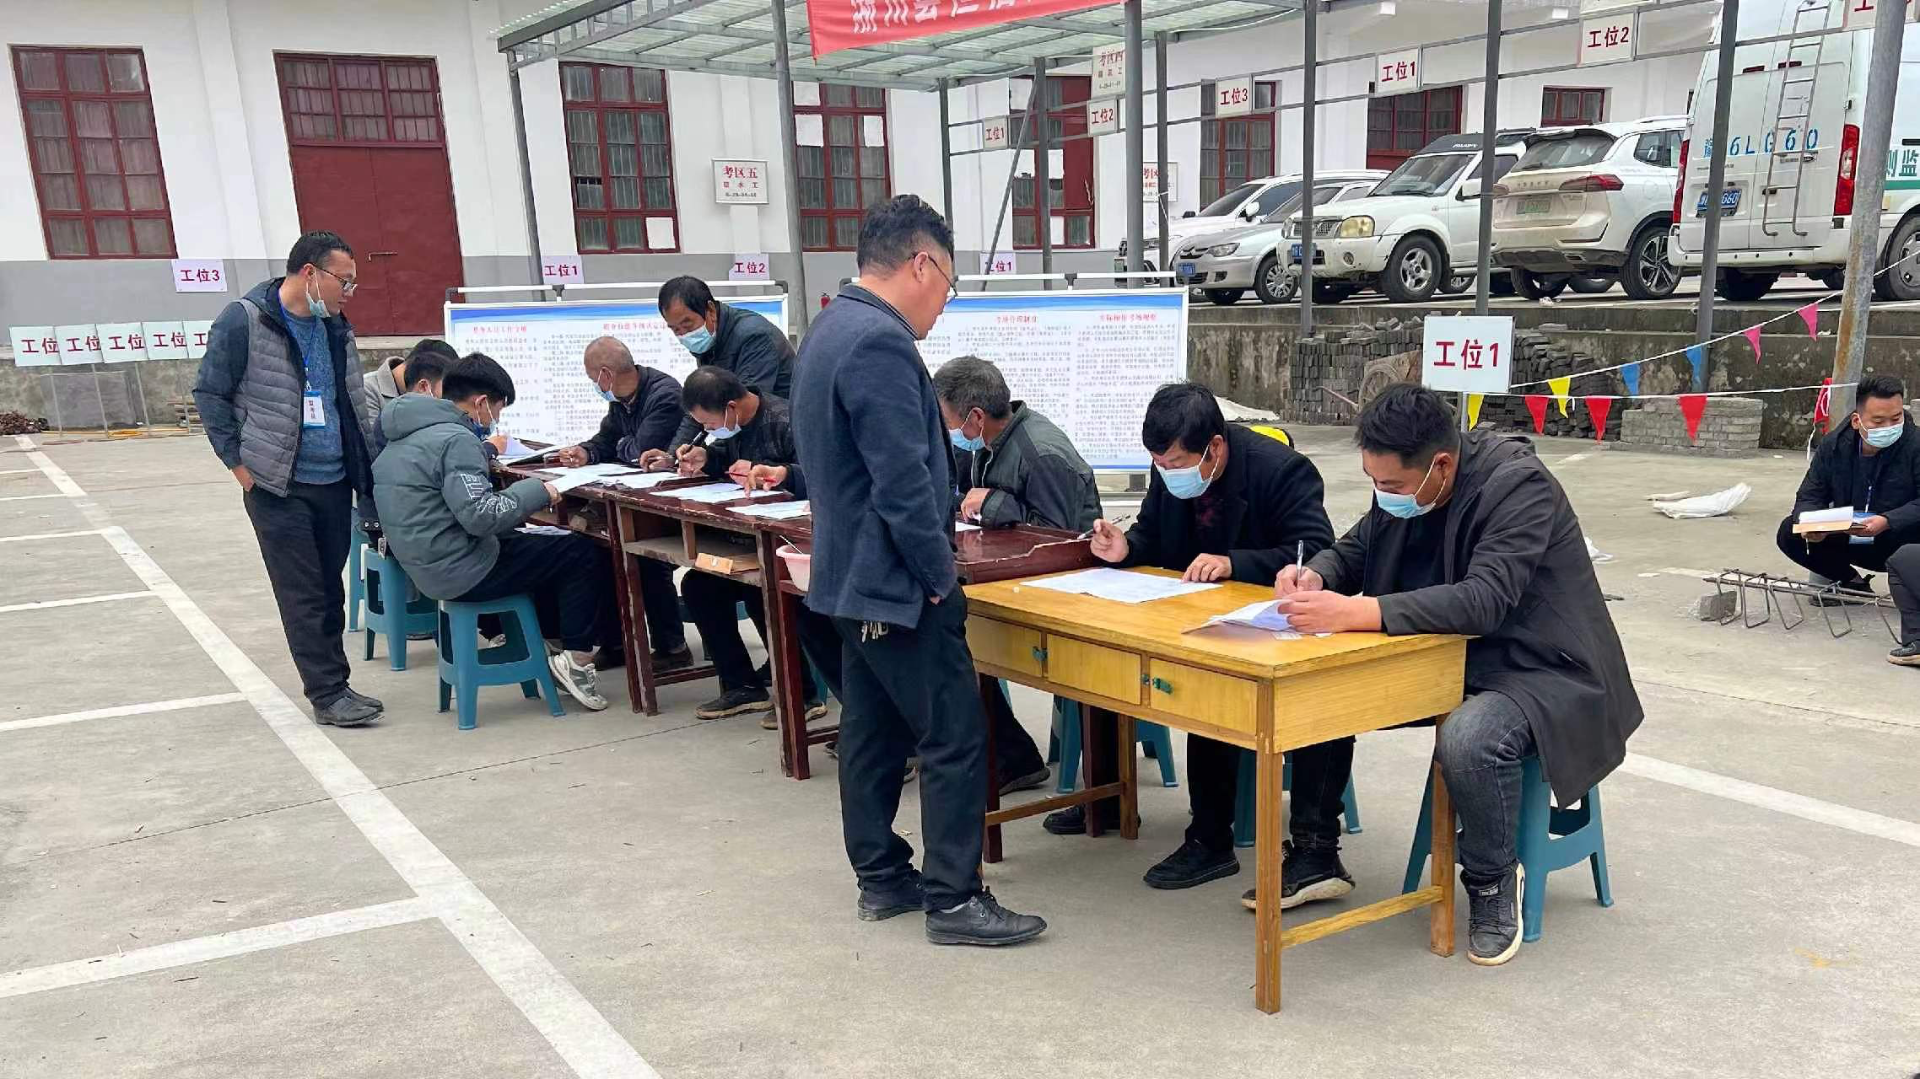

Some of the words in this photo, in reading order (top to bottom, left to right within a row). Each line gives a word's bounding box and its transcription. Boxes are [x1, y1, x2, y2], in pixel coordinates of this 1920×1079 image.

[1587, 26, 1630, 47] 工位2
[1381, 61, 1415, 82] 工位1
[1220, 87, 1248, 105] 工位3
[1091, 108, 1114, 124] 工位2
[985, 126, 1005, 141] 工位1
[180, 268, 220, 283] 工位3
[544, 264, 578, 277] 工位1
[734, 261, 766, 274] 工位2
[1433, 339, 1499, 370] 工位1
